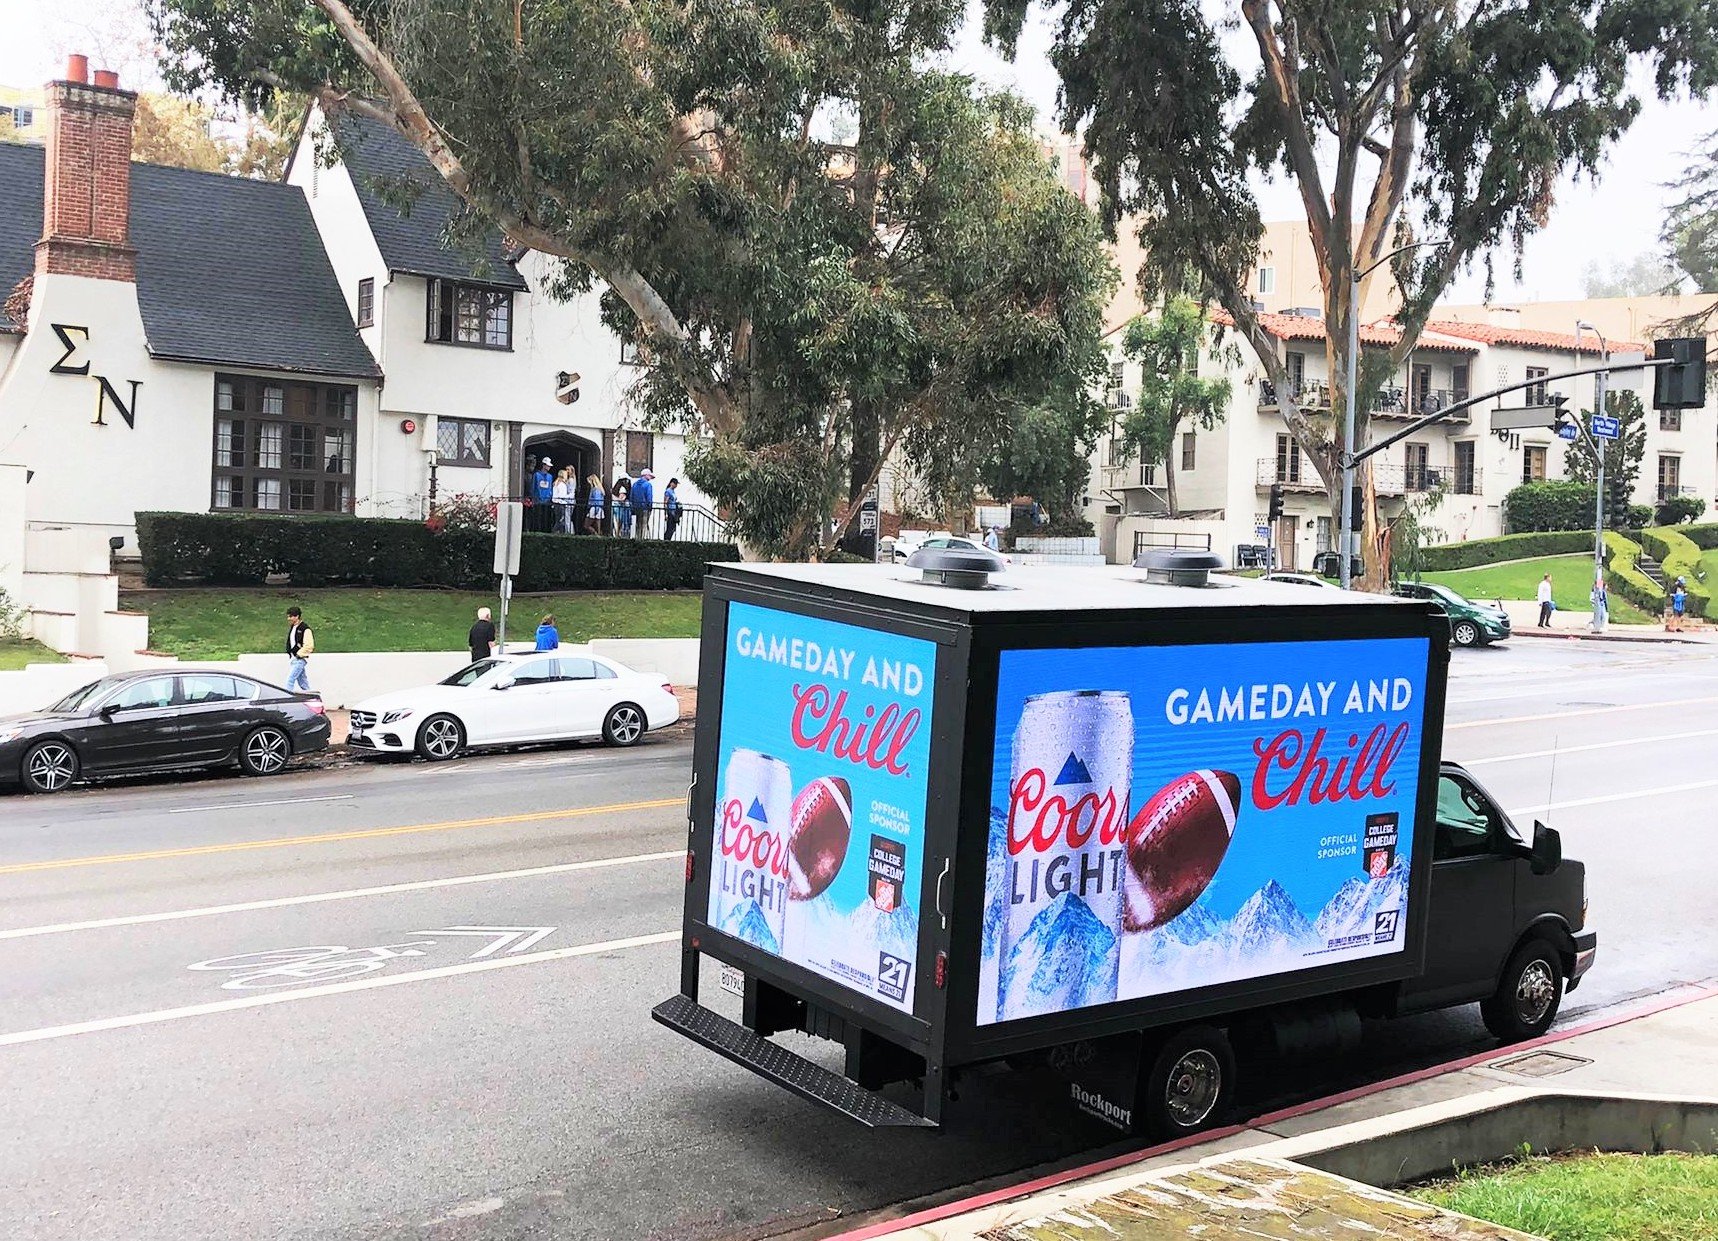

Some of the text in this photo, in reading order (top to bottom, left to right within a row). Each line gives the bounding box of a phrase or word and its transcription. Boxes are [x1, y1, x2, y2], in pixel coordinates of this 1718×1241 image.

[736, 626, 924, 697] GAMEDAY AND
[1165, 677, 1413, 726] GAMEDAY AND
[791, 683, 921, 776] Chill
[1252, 721, 1409, 811] Chill
[869, 812, 911, 835] SPONSOR
[871, 801, 910, 822] OFFICIAL
[1320, 833, 1357, 847] OFFICIAL
[1363, 834, 1398, 849] GAMEDAY
[1368, 824, 1395, 836] COLLEGE
[873, 848, 902, 866] COLLEGE
[1317, 845, 1357, 860] SPONSOR
[868, 858, 905, 882] GAMEDAY
[1011, 849, 1123, 905] LIGHT
[722, 860, 785, 913] LIGHT
[1375, 911, 1398, 934] 21
[879, 956, 908, 990] 21
[1071, 1083, 1131, 1126] Rockport
